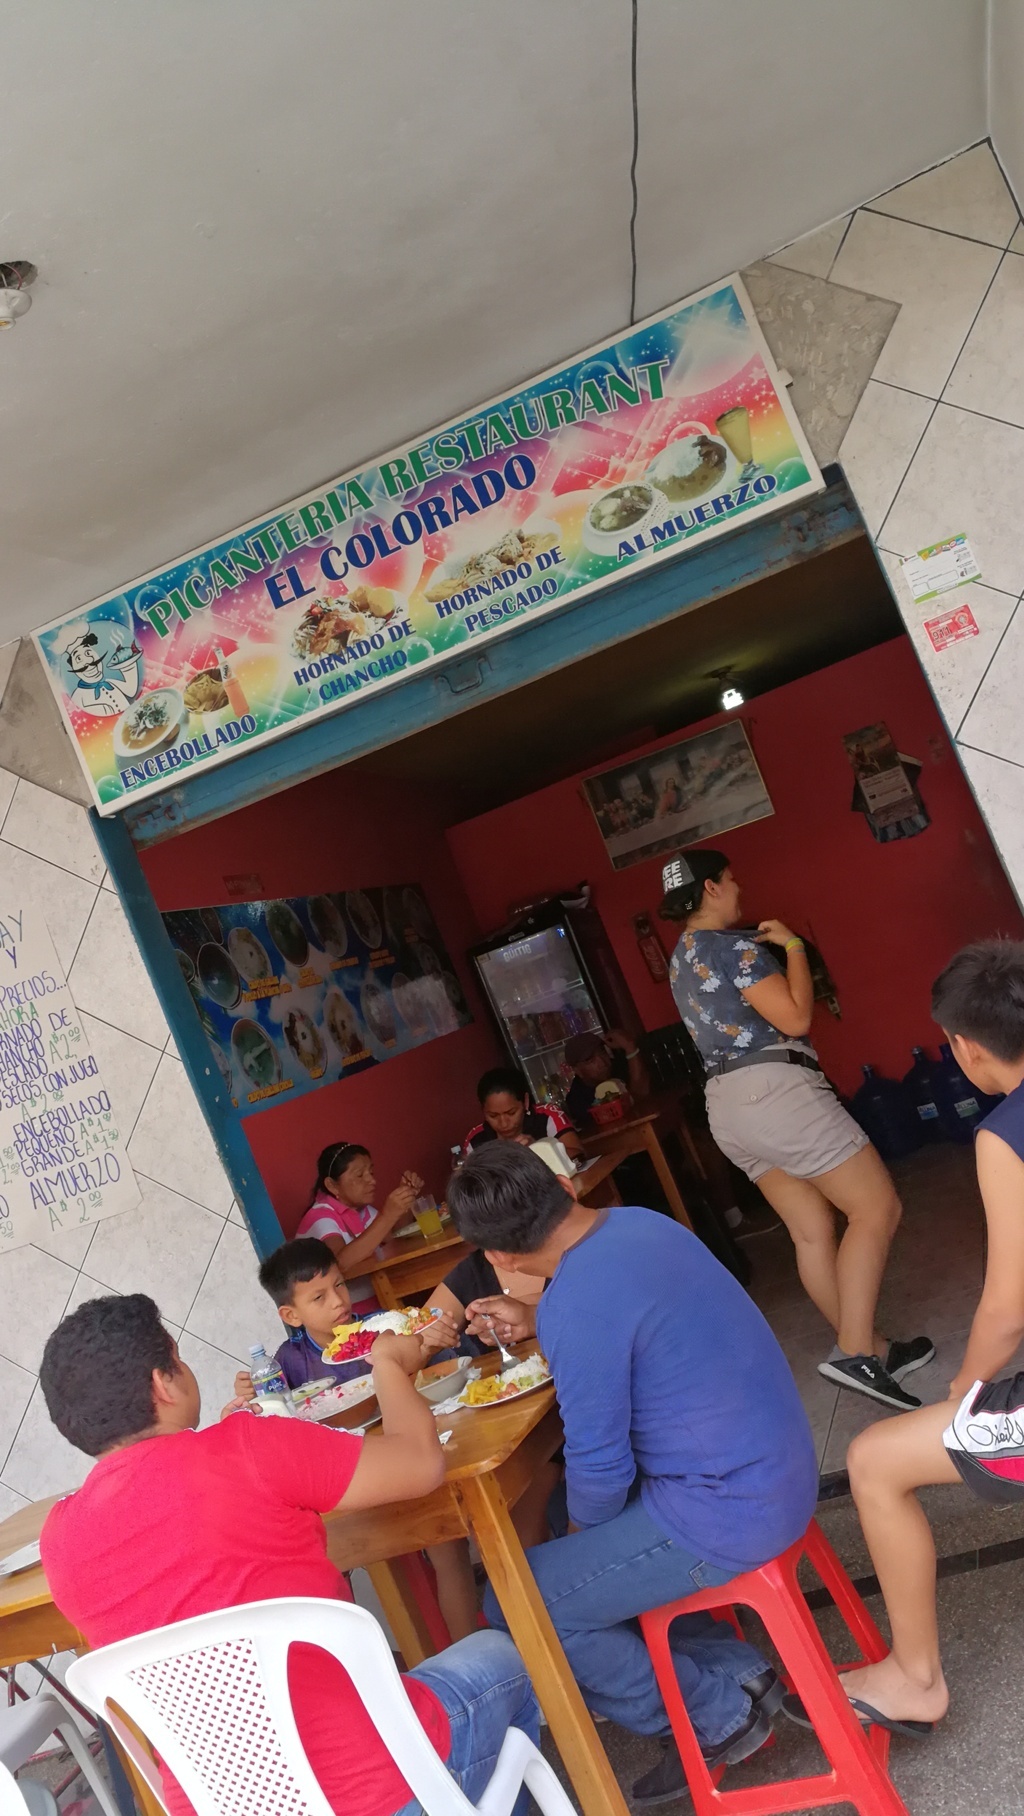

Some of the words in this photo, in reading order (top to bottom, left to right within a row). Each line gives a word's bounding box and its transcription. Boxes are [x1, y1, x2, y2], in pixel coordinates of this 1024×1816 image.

[146, 479, 377, 640] PICANTERIA
[378, 359, 670, 498] RESTAURANT
[616, 475, 776, 561] ALMUERZO
[264, 563, 316, 610] EL
[319, 454, 536, 582] COLORADO
[436, 561, 533, 619] HORNADO
[536, 546, 566, 573] DE
[464, 578, 558, 632] PESCADO
[293, 633, 389, 686] HORNADO
[389, 617, 417, 643] DE
[318, 648, 408, 702] CHANCHO
[120, 713, 257, 789] ENCEBOLLADO
[5, 946, 17, 969] Y
[48, 1007, 72, 1031] DE
[13, 1090, 111, 1143] ENCEBOLLADO
[20, 1141, 85, 1178] GRANDE
[30, 1152, 121, 1210] ALMUERZO
[48, 1206, 63, 1232] A
[861, 1364, 875, 1379] FILA
